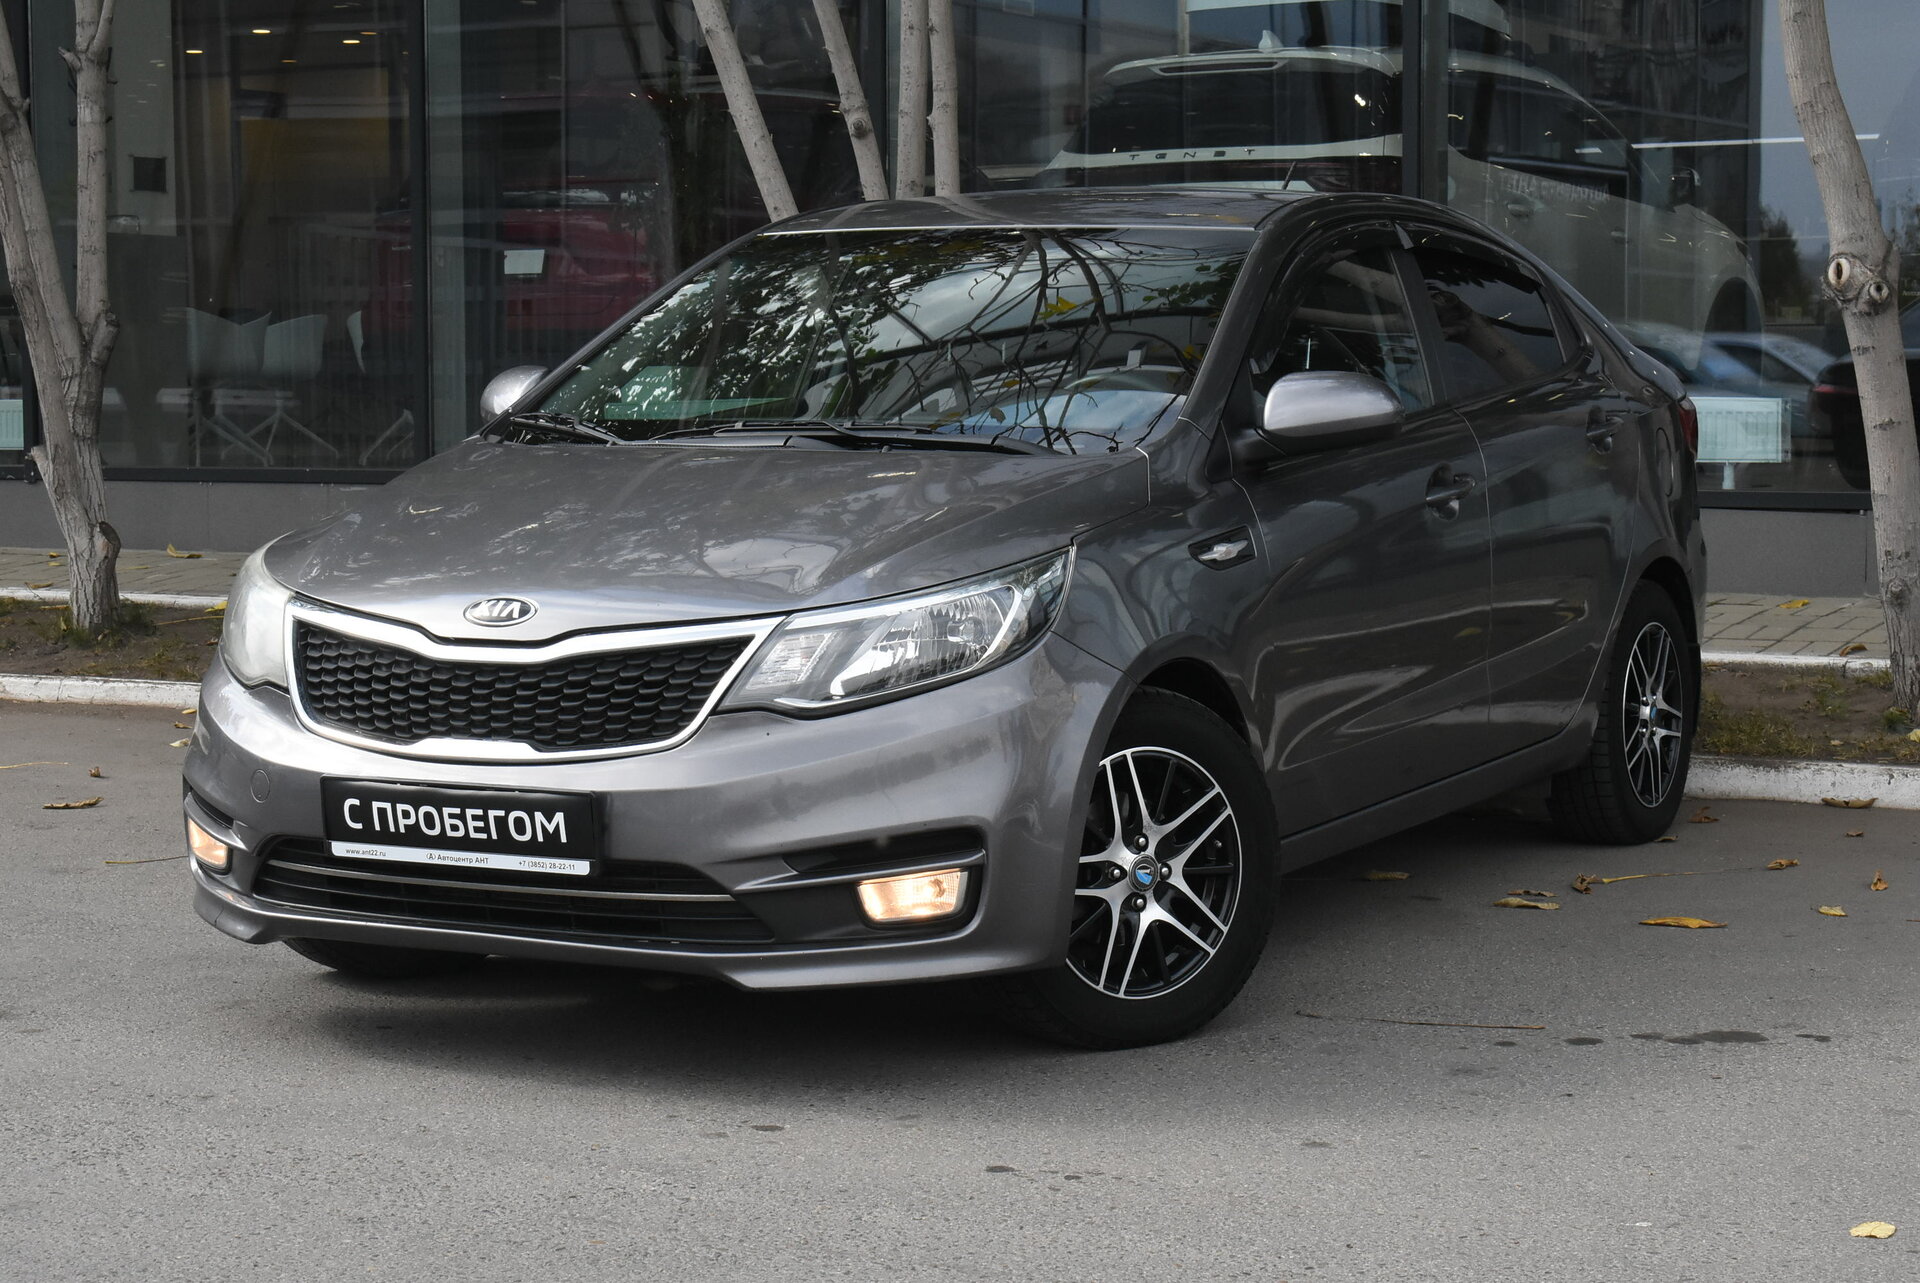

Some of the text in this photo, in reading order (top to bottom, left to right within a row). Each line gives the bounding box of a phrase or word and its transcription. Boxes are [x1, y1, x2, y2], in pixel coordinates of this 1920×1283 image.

[473, 600, 521, 619] KIA
[343, 798, 567, 843] С ПРОБЕГОМ
[437, 854, 474, 864] Автоцентр
[474, 857, 489, 865] АНТ
[527, 861, 548, 870] (3852)
[548, 863, 576, 871] 28-22-11
